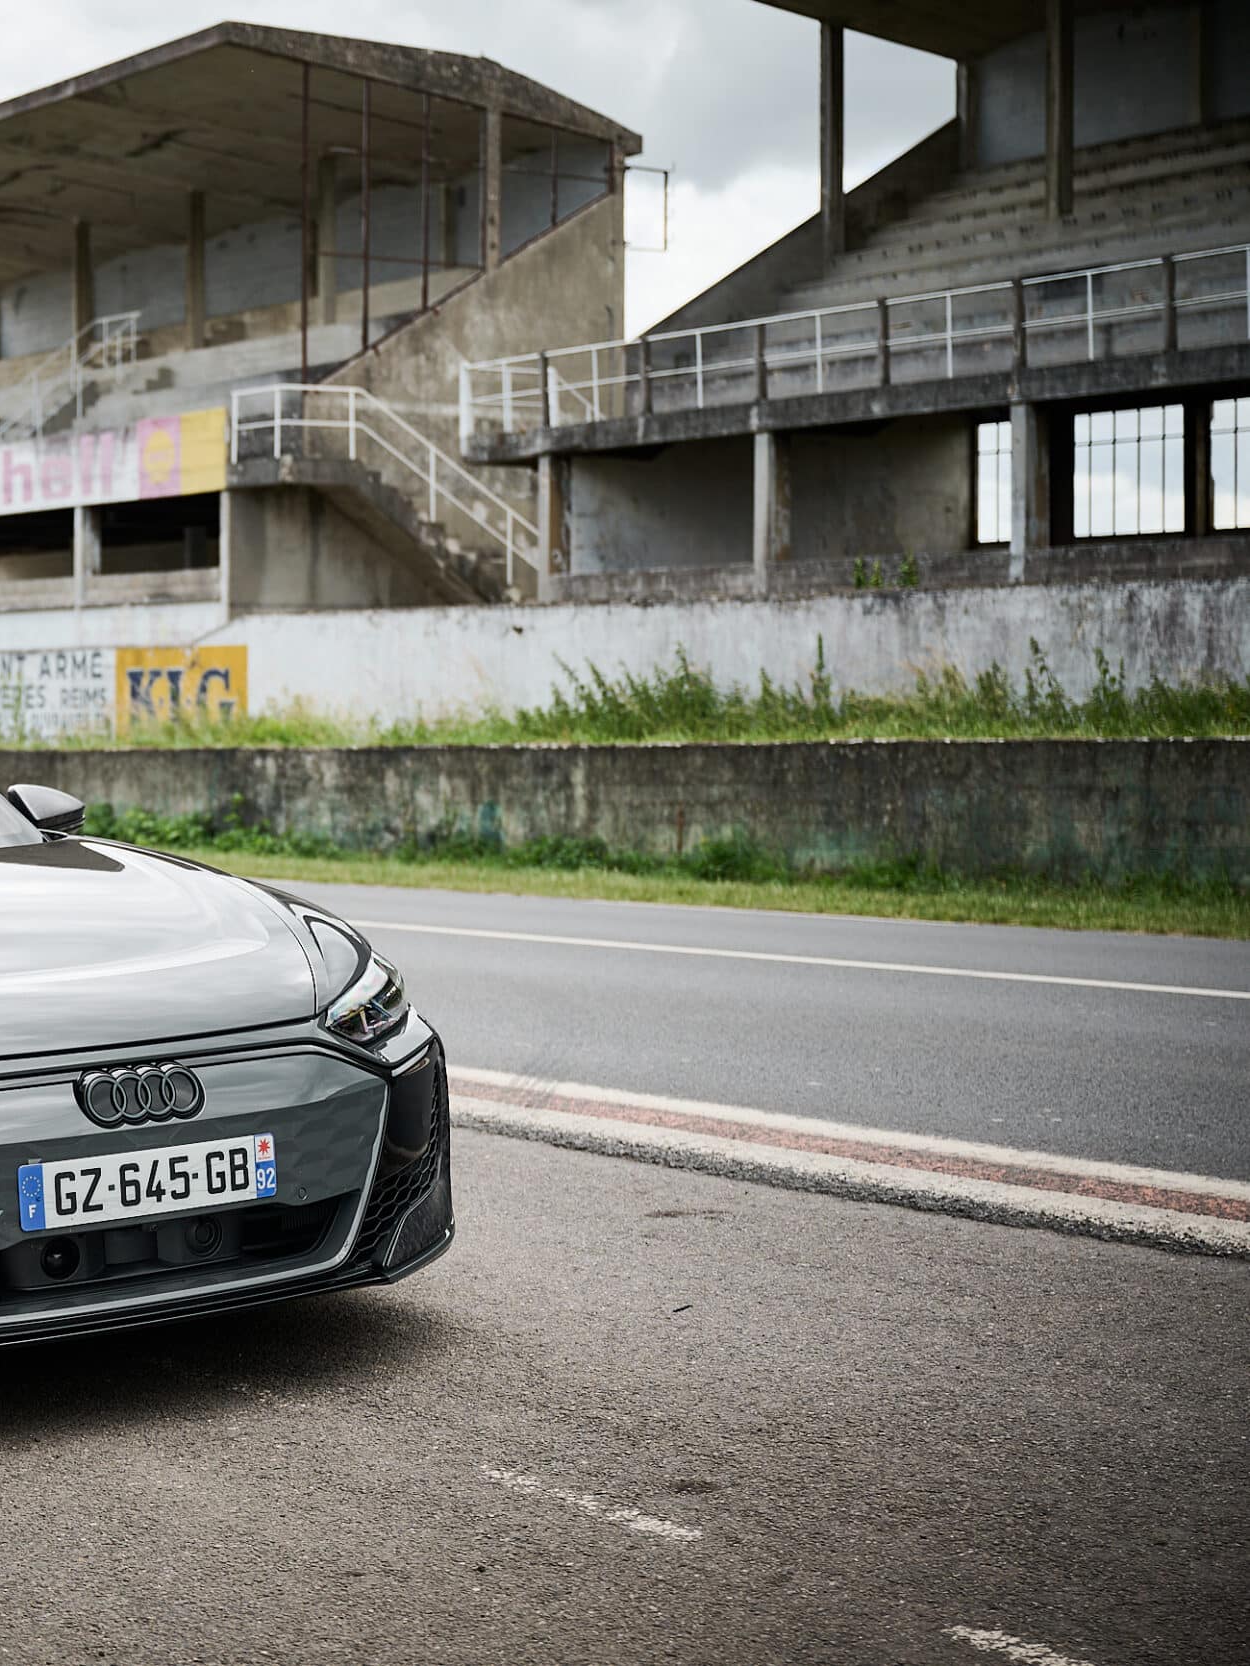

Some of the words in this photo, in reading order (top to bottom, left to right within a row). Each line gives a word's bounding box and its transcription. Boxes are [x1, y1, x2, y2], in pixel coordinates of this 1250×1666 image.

[61, 685, 108, 708] REIMS
[257, 1167, 276, 1190] 92
[28, 1204, 37, 1219] F
